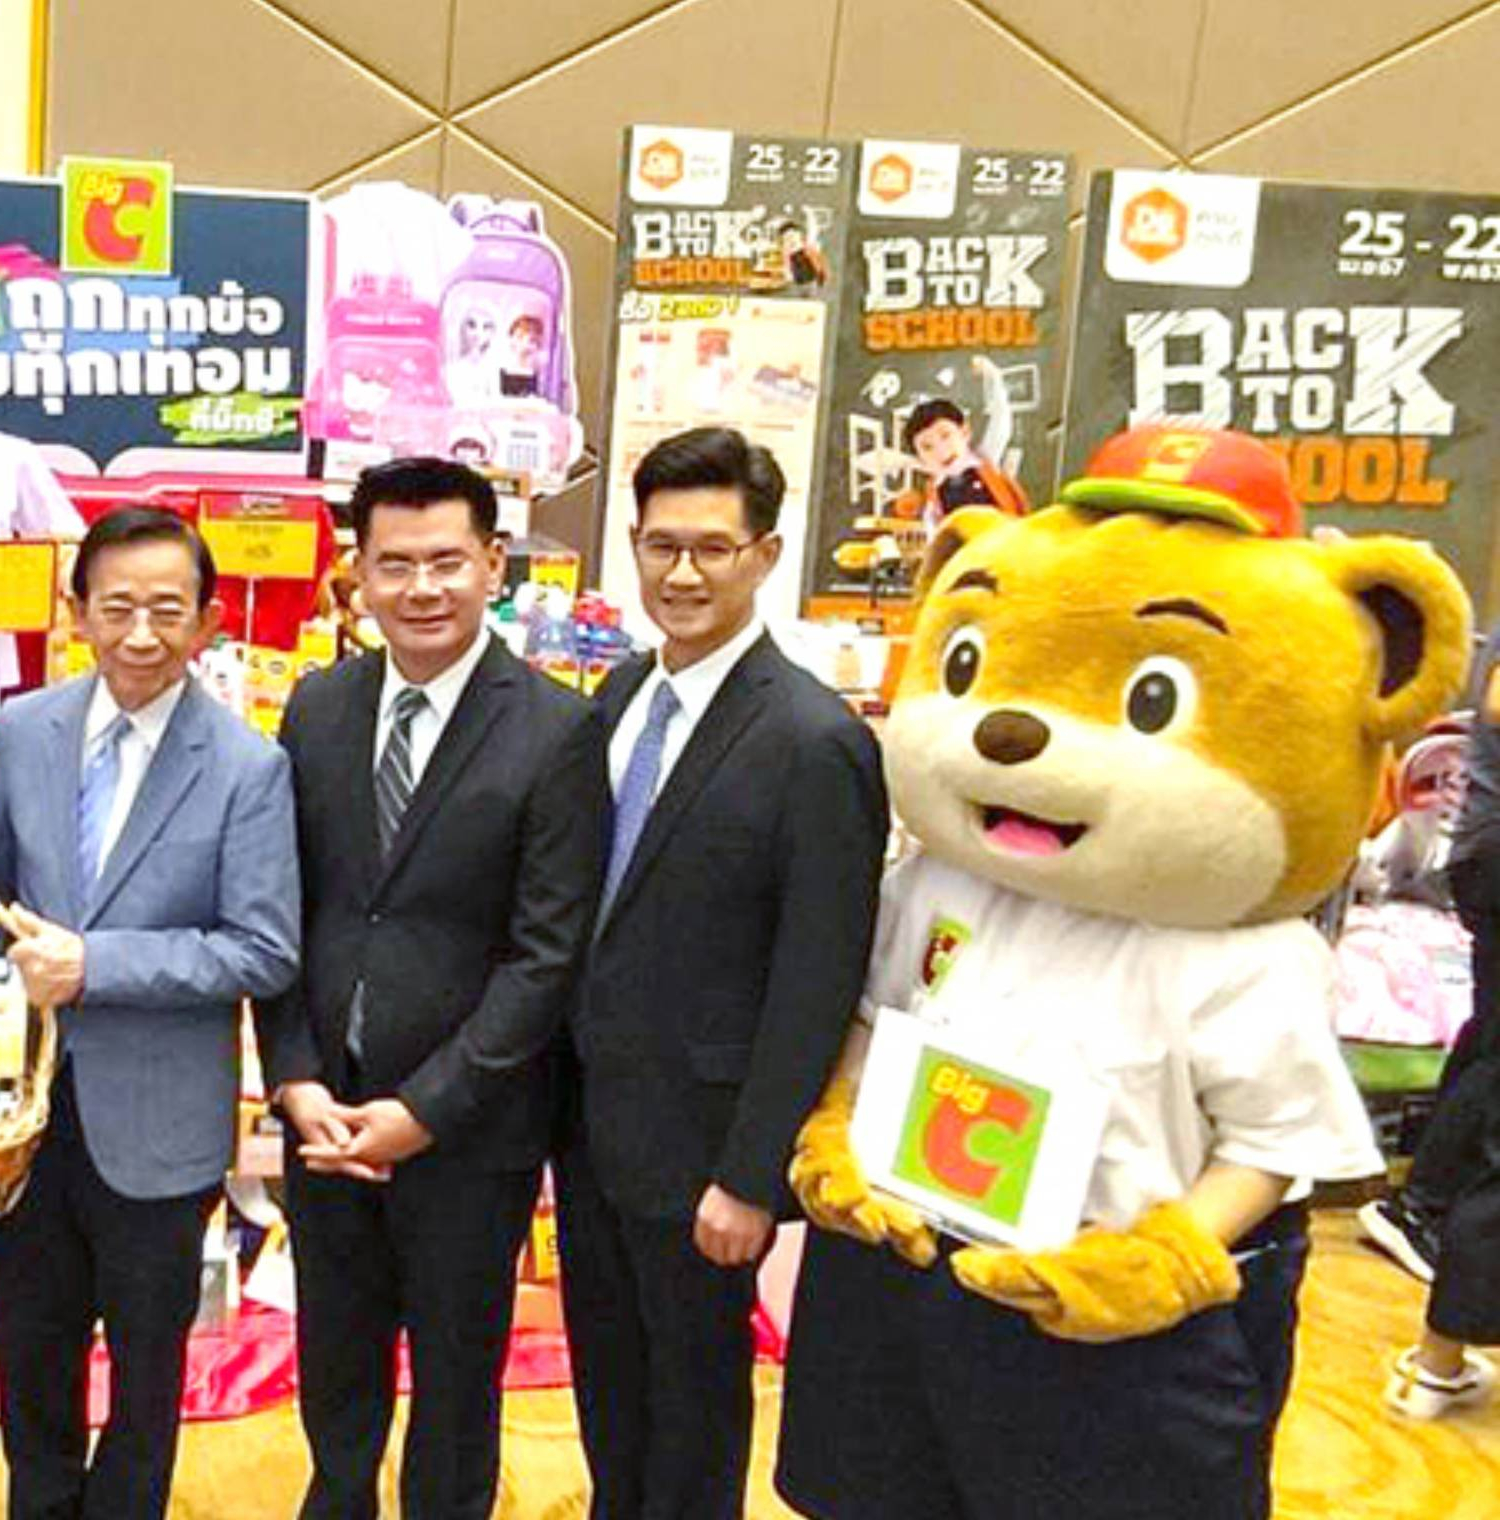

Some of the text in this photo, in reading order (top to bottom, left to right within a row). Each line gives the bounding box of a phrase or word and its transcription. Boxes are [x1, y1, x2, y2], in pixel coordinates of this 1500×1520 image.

[747, 145, 783, 170] 25
[803, 147, 841, 172] 22
[973, 157, 1009, 183] 25
[1029, 160, 1065, 186] 22
[79, 171, 123, 205] Big
[1338, 209, 1406, 257] 25
[1443, 214, 1500, 260] 22
[862, 234, 1048, 312] BACK
[927, 274, 981, 306] TO
[863, 306, 1040, 350] SCHOOL
[1125, 305, 1465, 437] BACK
[1240, 372, 1336, 432] TO
[927, 1065, 988, 1115] Big
[922, 1085, 1034, 1201] C
